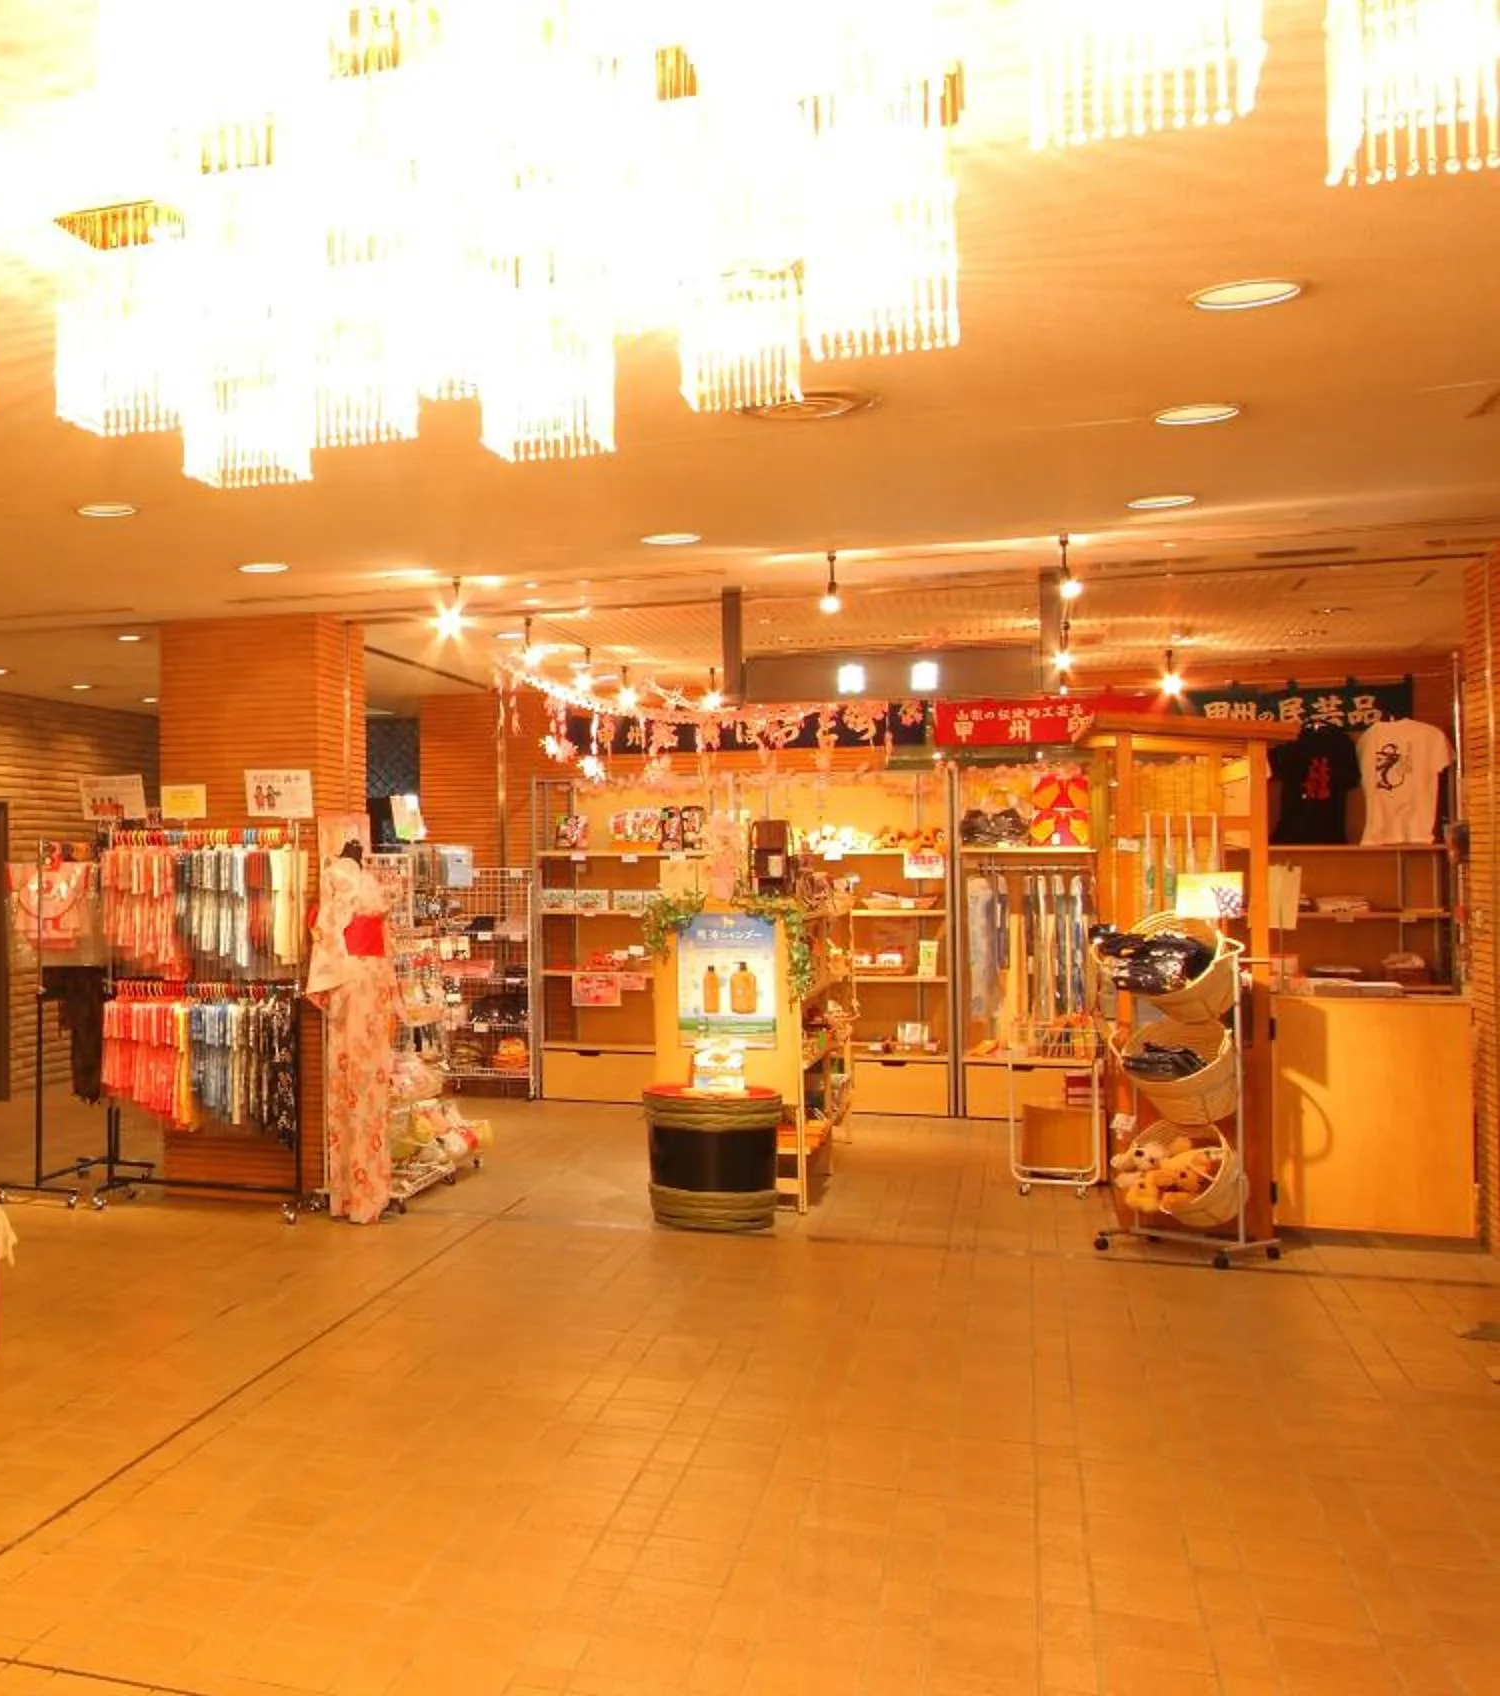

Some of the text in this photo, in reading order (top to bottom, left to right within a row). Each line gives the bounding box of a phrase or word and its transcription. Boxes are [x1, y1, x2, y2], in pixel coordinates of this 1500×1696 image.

[1203, 694, 1383, 726] 甲州の民芸品
